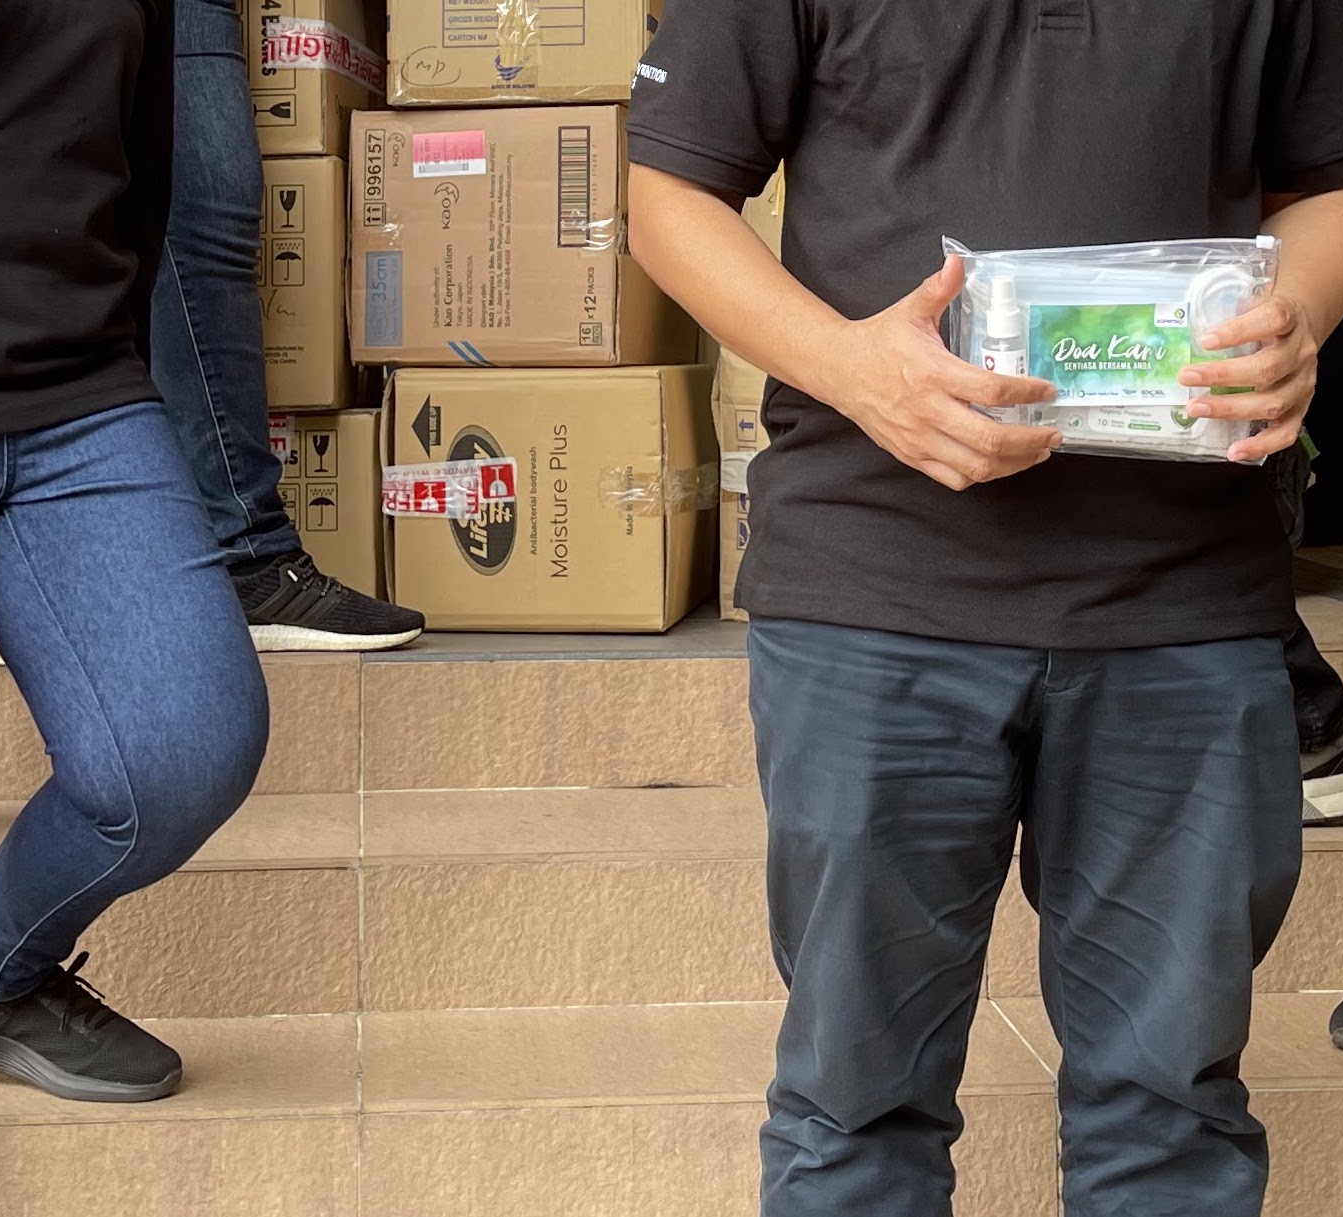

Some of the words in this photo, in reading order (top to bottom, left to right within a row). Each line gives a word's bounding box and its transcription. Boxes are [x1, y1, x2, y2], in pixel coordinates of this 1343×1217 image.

[261, 0, 282, 10] 4
[448, 34, 475, 42] CARTON
[368, 133, 382, 197] 996157
[442, 198, 451, 230] kao
[372, 257, 387, 302] 35cm
[443, 244, 455, 305] Corporation
[587, 266, 595, 295] PACKS
[466, 296, 473, 304] IN
[444, 308, 453, 327] Kao
[582, 328, 591, 343] 16
[1051, 337, 1102, 362] Doa
[1064, 362, 1097, 371] SENTIASA
[1098, 362, 1131, 370] BERSAMA
[1132, 362, 1152, 370] ANDA
[549, 424, 568, 471] Plus
[529, 446, 538, 494] bodywash
[625, 503, 633, 511] in
[529, 497, 538, 556] Antibacterial
[550, 479, 568, 578] Moisture
[625, 514, 634, 536] Made
